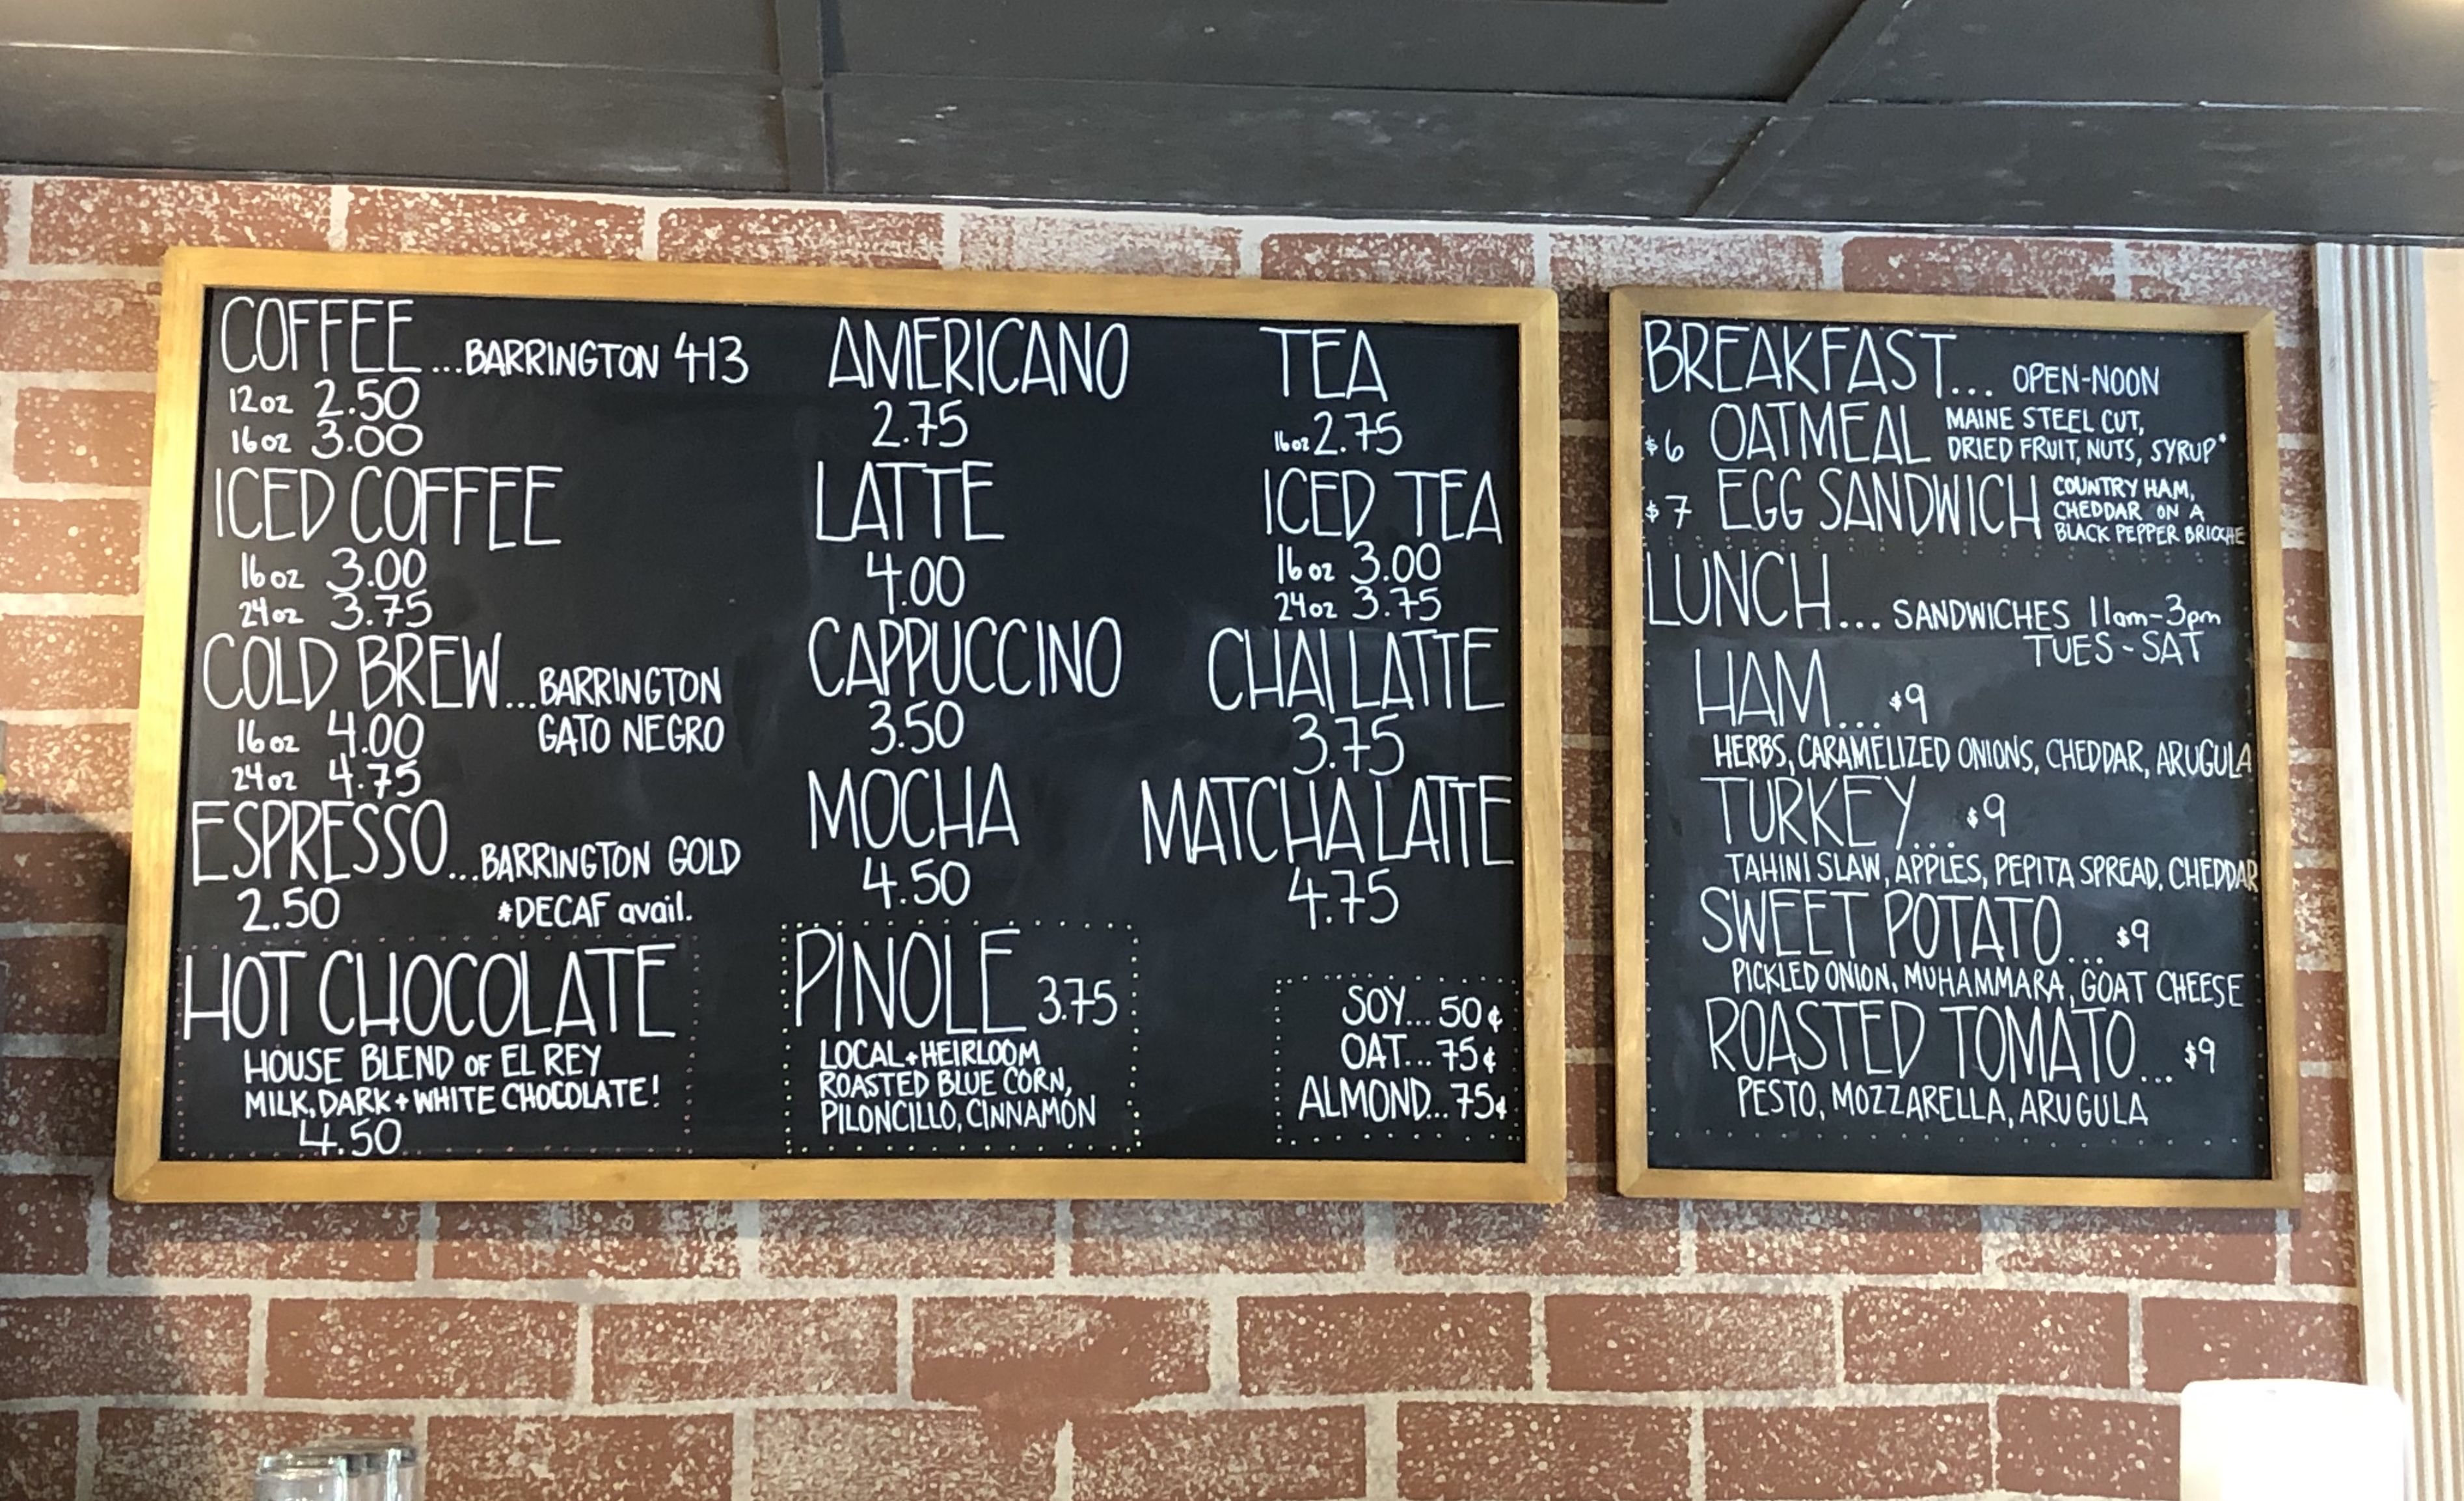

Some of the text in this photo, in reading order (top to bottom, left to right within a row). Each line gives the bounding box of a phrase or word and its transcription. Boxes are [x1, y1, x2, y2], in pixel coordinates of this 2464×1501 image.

[465, 338, 659, 380] BARRINGTON
[674, 331, 750, 385] 413
[828, 317, 1129, 400] AMERICANO
[1259, 326, 1388, 403] TEA
[2012, 362, 2159, 398] OPEN-NOON
[314, 376, 420, 422] 2.50
[1945, 406, 2145, 437] MAINE STEEL CUT,
[311, 418, 424, 459] 3.00
[871, 399, 969, 448] 2.75
[1313, 410, 1403, 456] 2.75
[1710, 401, 1932, 466] OATMEAL
[1947, 435, 2014, 463] DRIED
[2019, 435, 2081, 466] FRUIT,
[2087, 437, 2143, 468] NUTS,
[216, 465, 563, 552] ICED COFFEE
[815, 459, 1005, 543] LATTE
[1264, 467, 1503, 545] ICED TEA
[1717, 467, 1804, 532] EGG
[1819, 467, 2042, 541] SANDWICH
[2052, 475, 2195, 502] COUNTRY HAM,
[2053, 500, 2205, 522] CHEDDAR ON A
[2053, 521, 2245, 546] BLACK PEPPER BRIOCHE
[325, 547, 427, 592] 3.00
[866, 550, 966, 615] 4.00
[1350, 540, 1442, 585] 3.00
[326, 585, 433, 631] 3.75
[1351, 585, 1442, 622] 3.75
[1893, 598, 2070, 632] SANDWICHES
[203, 632, 338, 712] COLD
[539, 666, 722, 708] BARRINGTON
[807, 615, 1122, 698] CAPPUCCINO
[1208, 627, 1505, 714] CHAI LATTE
[327, 709, 425, 760] 4.00
[537, 712, 725, 757] GATO NEGRO
[868, 699, 965, 755] 3.50
[1292, 712, 1405, 777] 3.75
[329, 752, 422, 800] 4.75
[1713, 733, 2252, 779] HERBS, CARAMELIZED ONIONS, CHEDDAR, ARUGULA
[807, 762, 1020, 850] MOCHA
[1141, 774, 1514, 869] MATCHA LATTE
[480, 840, 651, 883] BARRINGTON
[668, 835, 742, 876] GOLD
[862, 856, 971, 910] 4.50
[1724, 851, 2258, 893] TAHINI SLAW, APPLES, PEPITA SPREAD, CHEDDAR
[237, 886, 340, 932] 2.50
[617, 889, 693, 925] avail.
[1287, 866, 1399, 930] 4.75
[1699, 886, 1869, 960] SWEET
[183, 942, 677, 1042] HOT CHOCOLATE
[795, 928, 1118, 1035] PINOLE 3.75
[1731, 957, 2244, 1009] PICKLED ONION, MUHAMMARA, GOAT CHEESE
[1705, 996, 1925, 1079] ROASTED
[243, 1047, 345, 1085] HOUSE
[360, 1043, 455, 1082] BLEND
[500, 1043, 537, 1078] EL
[543, 1042, 602, 1077] REY
[819, 1067, 1072, 1100] ROASTED BLUE CORN,
[413, 1085, 496, 1115] WHITE
[501, 1074, 660, 1113] CHOCOLATE!
[820, 1094, 1096, 1135] PILONCILLO, CINNAMON
[1737, 1074, 2149, 1129] PESTO, MOZZARELLA, ARUGULA
[299, 1118, 401, 1157] 4.50
